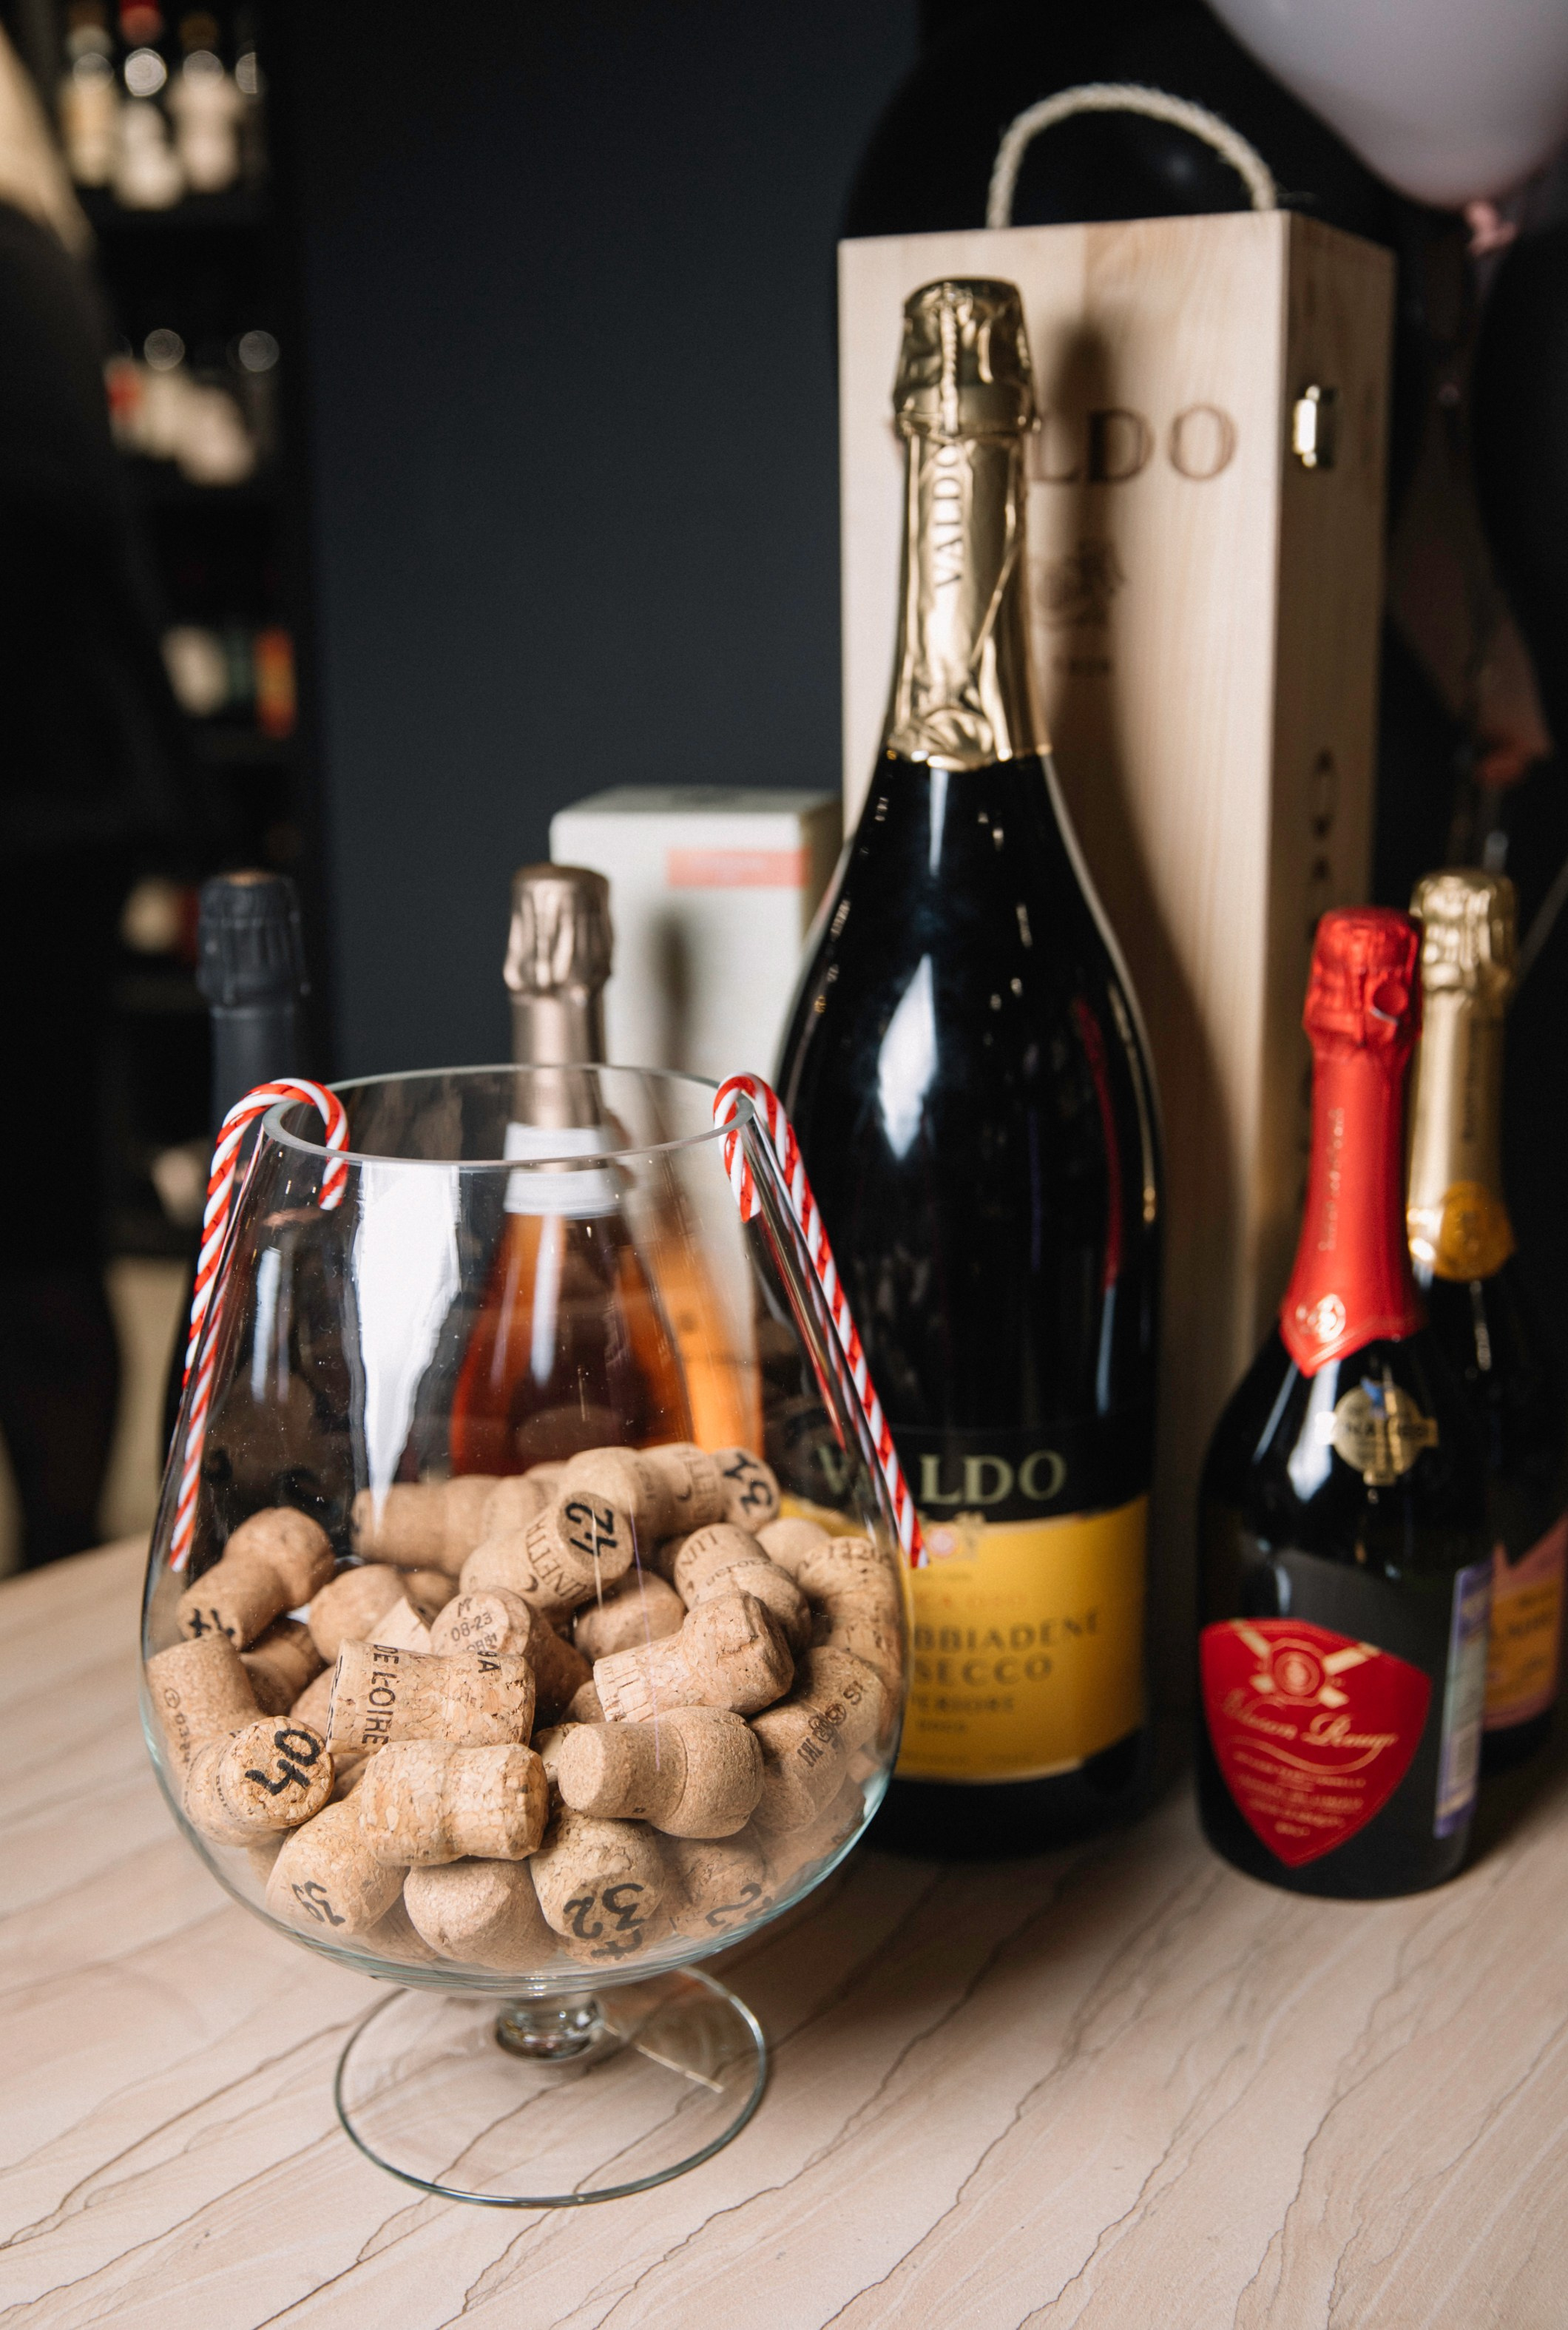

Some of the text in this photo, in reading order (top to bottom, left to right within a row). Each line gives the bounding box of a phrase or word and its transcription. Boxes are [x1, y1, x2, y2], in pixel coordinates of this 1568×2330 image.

[1029, 403, 1237, 482] LDO
[933, 445, 964, 587] VALDO
[817, 1447, 1067, 1505] VLDO
[524, 1519, 589, 1604] UNETTA
[564, 1499, 618, 1556] 42
[450, 1610, 493, 1641] 08-23
[362, 1670, 397, 1746] LOIRE
[244, 1728, 322, 1798] 40
[564, 1882, 646, 1939] 32
